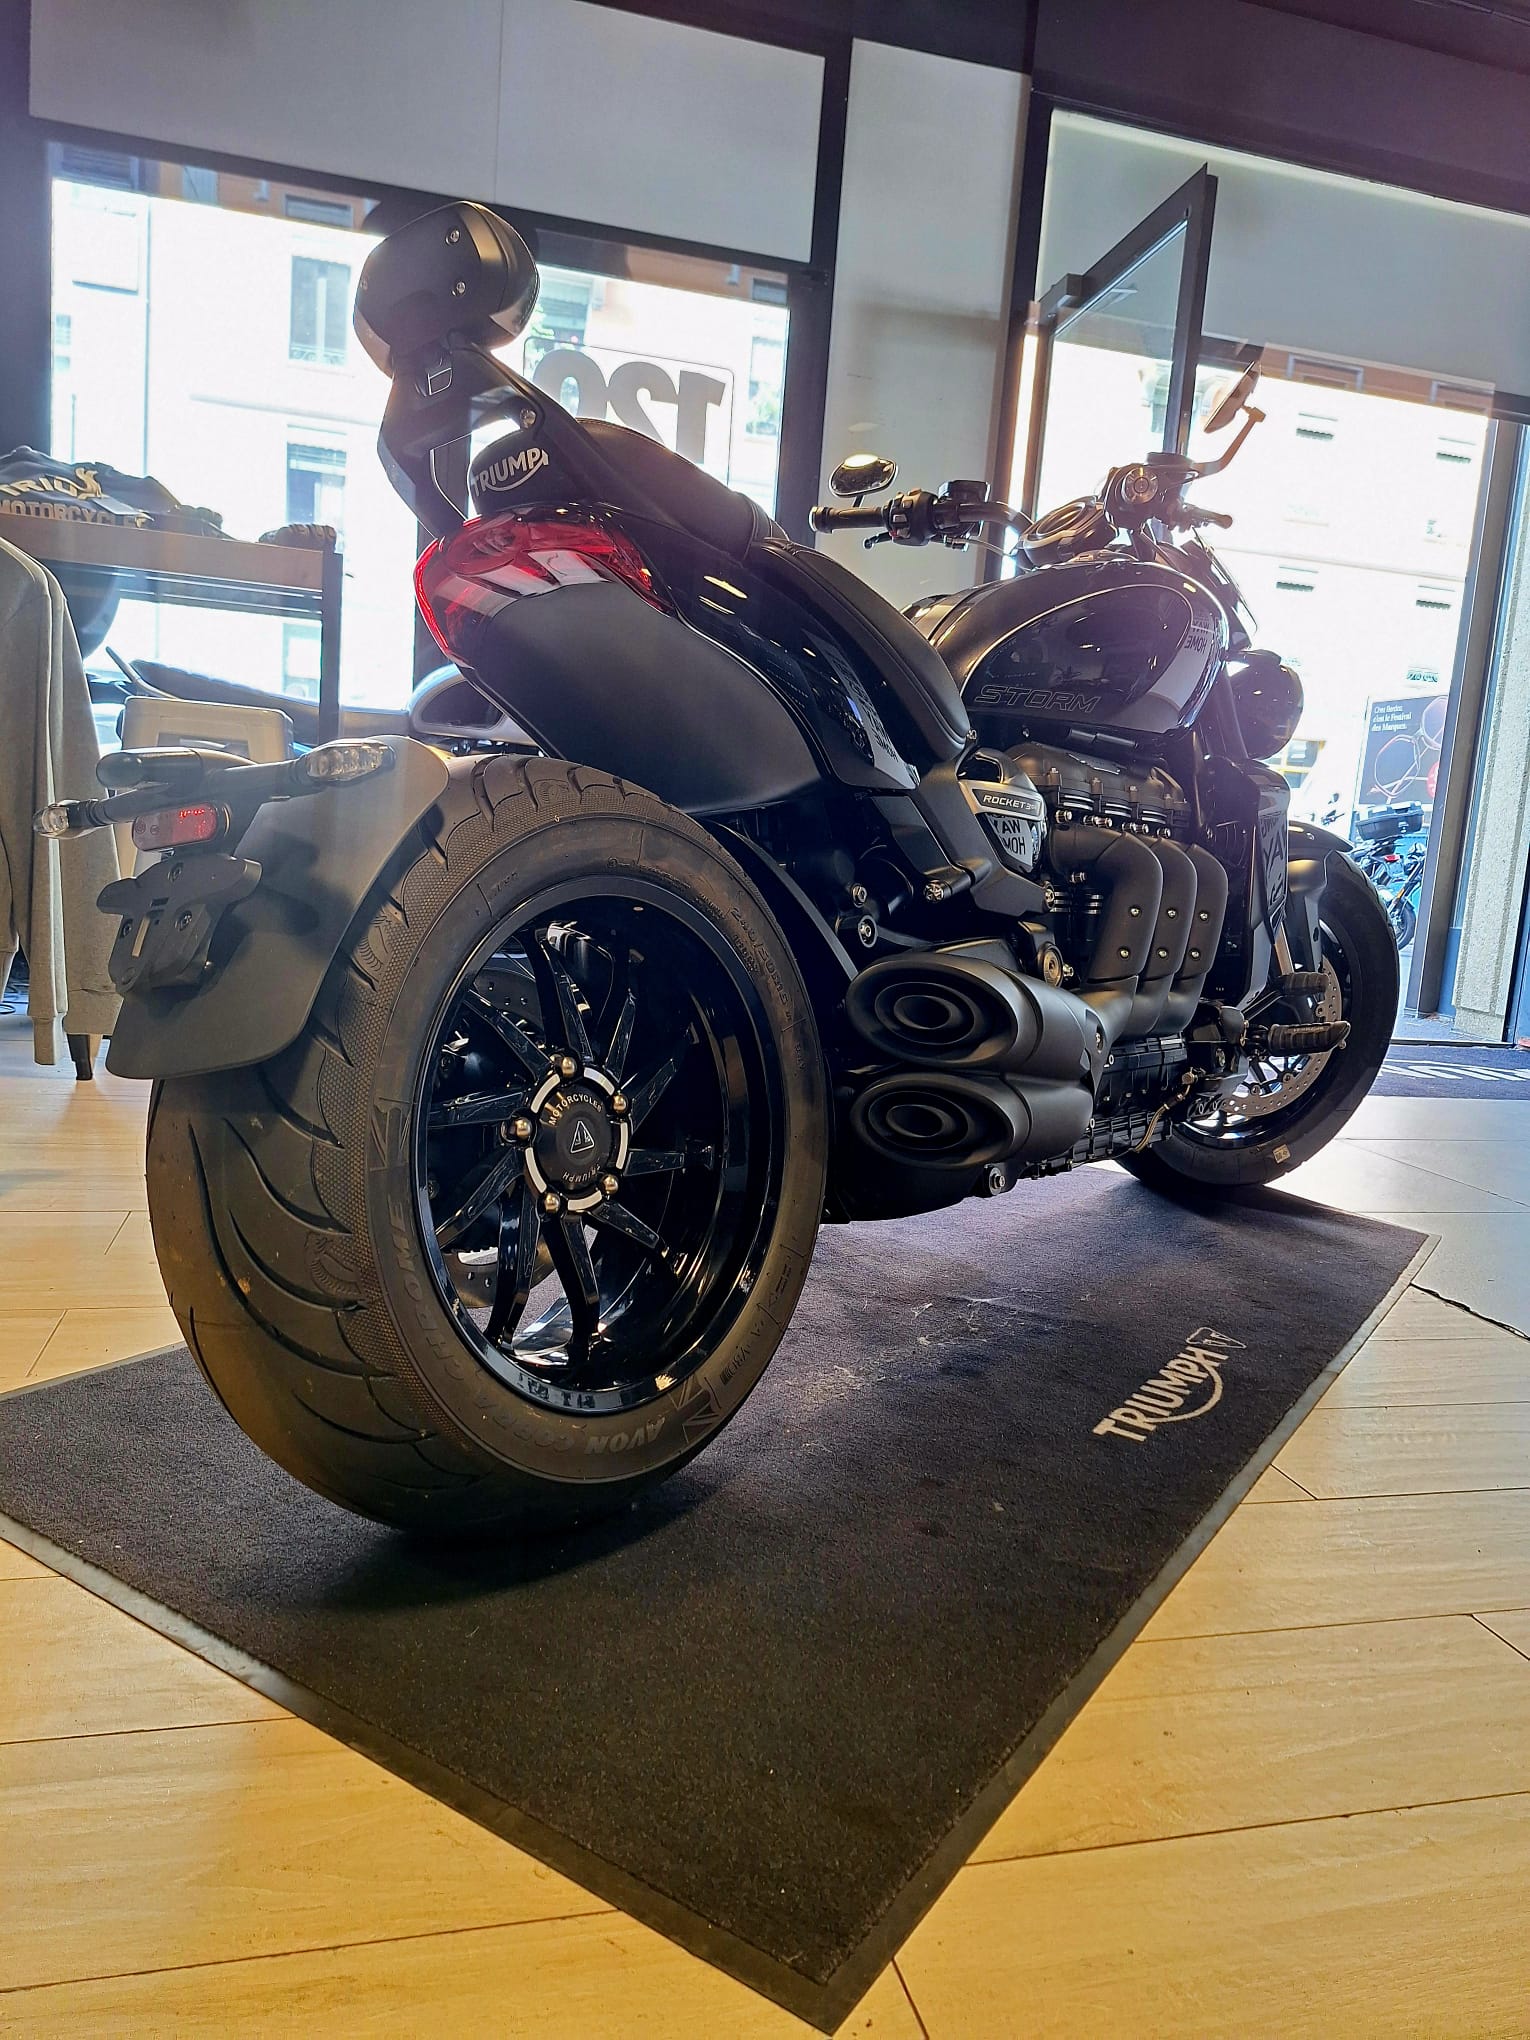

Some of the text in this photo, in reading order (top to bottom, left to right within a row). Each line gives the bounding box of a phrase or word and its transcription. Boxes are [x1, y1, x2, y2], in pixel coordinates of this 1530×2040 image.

[974, 684, 1102, 713] STORM
[548, 1093, 603, 1127] MOTORCYCLES
[1092, 1345, 1230, 1442] TRIUMPH
[584, 1417, 666, 1455] AVON
